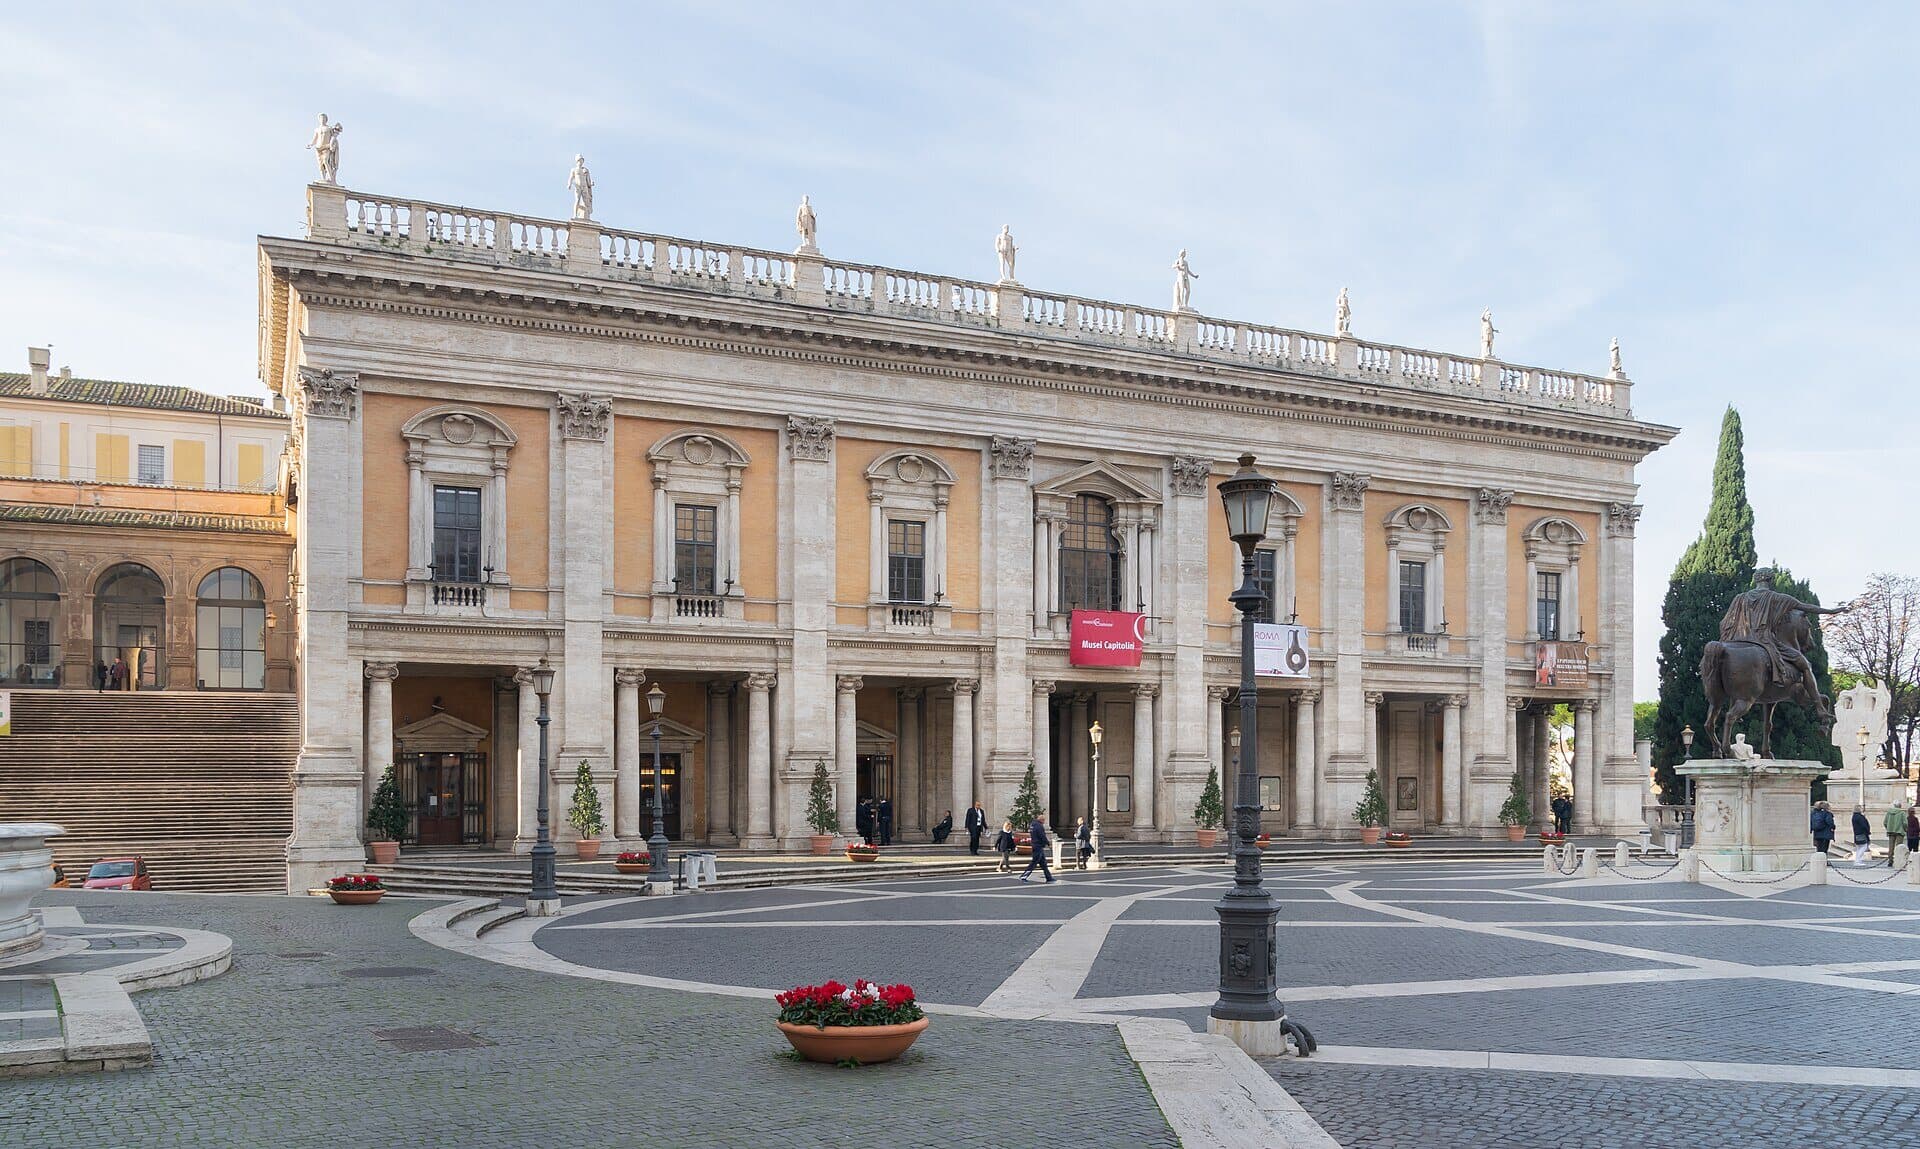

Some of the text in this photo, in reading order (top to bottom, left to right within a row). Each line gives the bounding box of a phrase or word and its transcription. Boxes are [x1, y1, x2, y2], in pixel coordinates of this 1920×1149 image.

[1255, 631, 1280, 640] ROMA
[1081, 640, 1135, 650] Musei Capitolini
